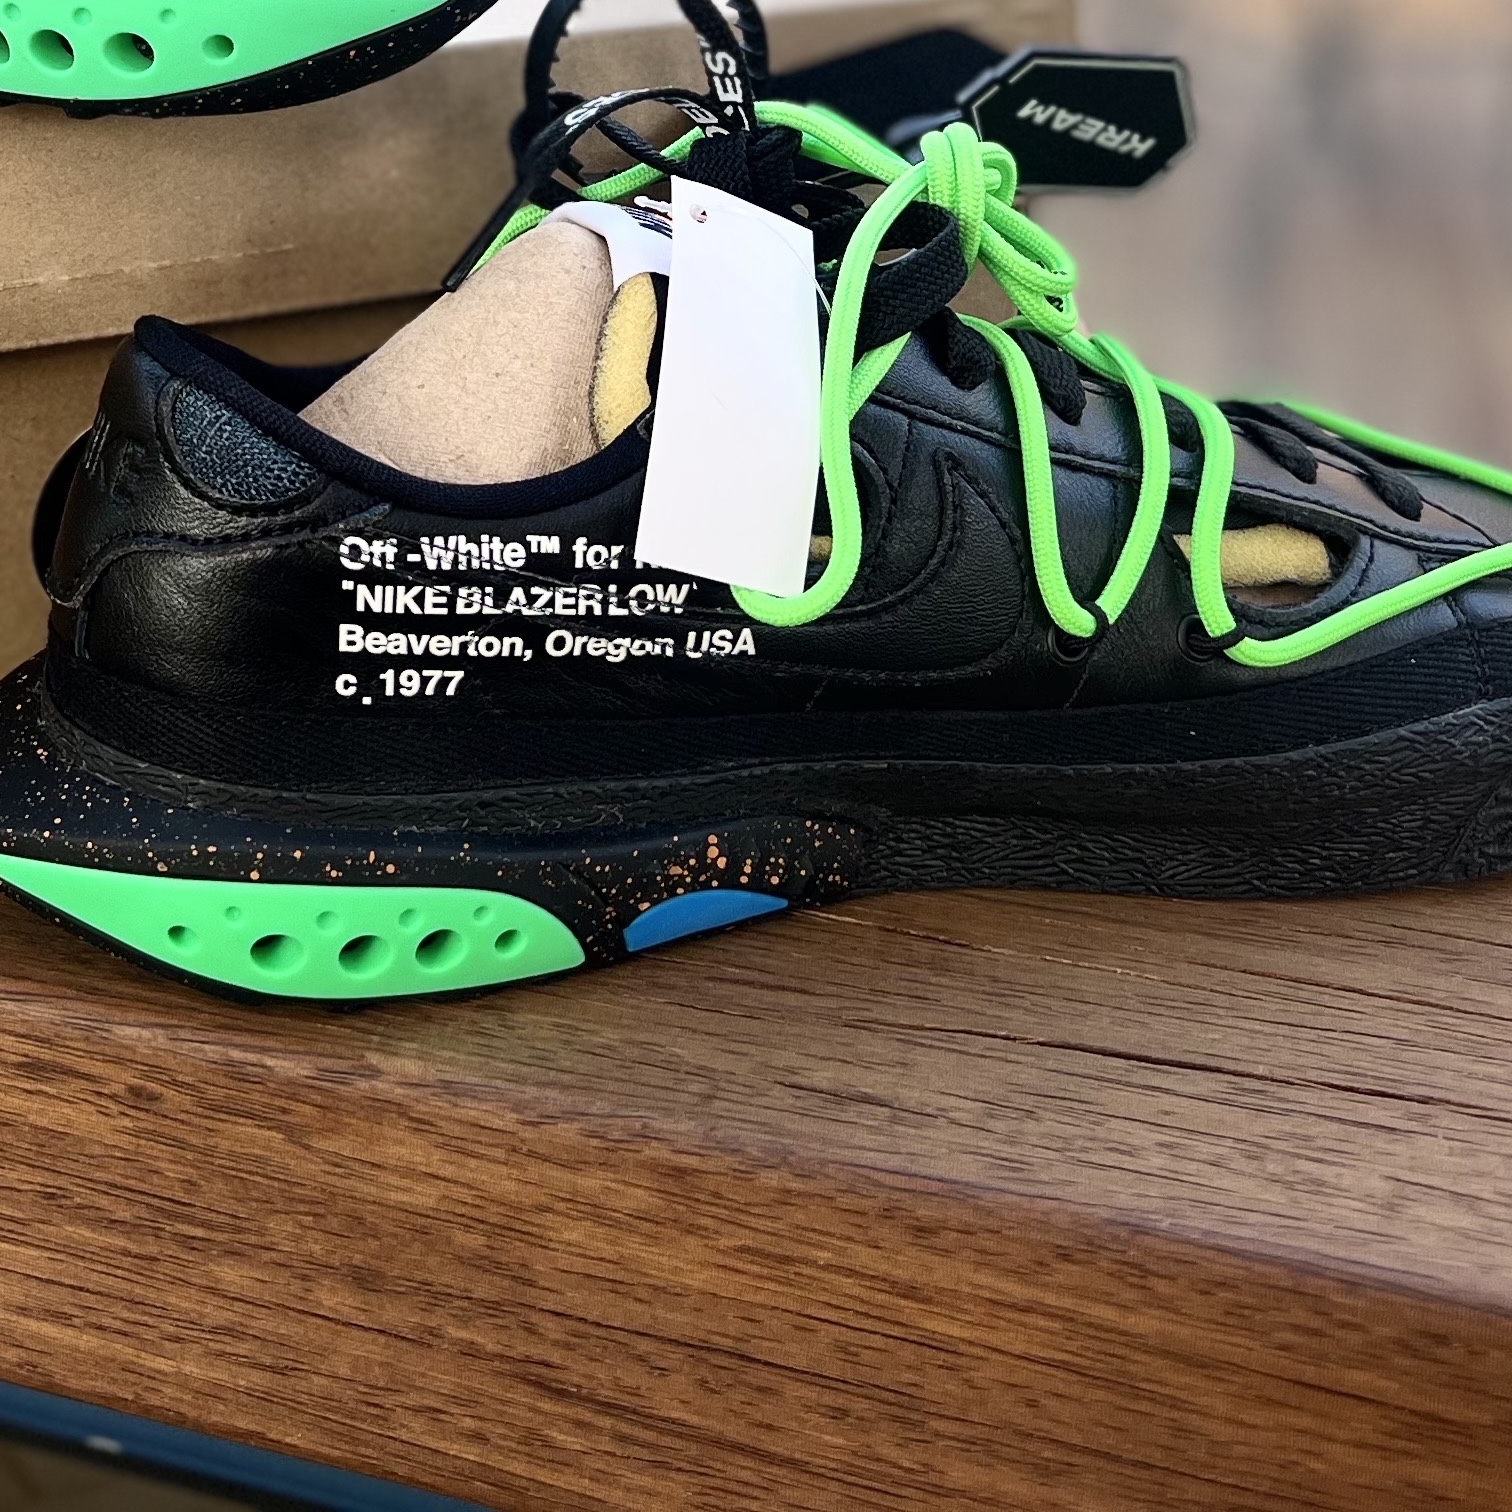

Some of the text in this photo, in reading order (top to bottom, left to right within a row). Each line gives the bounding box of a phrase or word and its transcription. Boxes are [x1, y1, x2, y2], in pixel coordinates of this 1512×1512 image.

[1016, 99, 1157, 159] KREAM
[339, 536, 398, 571] Off
[572, 537, 625, 570] for
[456, 584, 605, 616] BLAZER
[338, 624, 757, 663] Beaverton, Oregon USA
[378, 669, 465, 697] 1977
